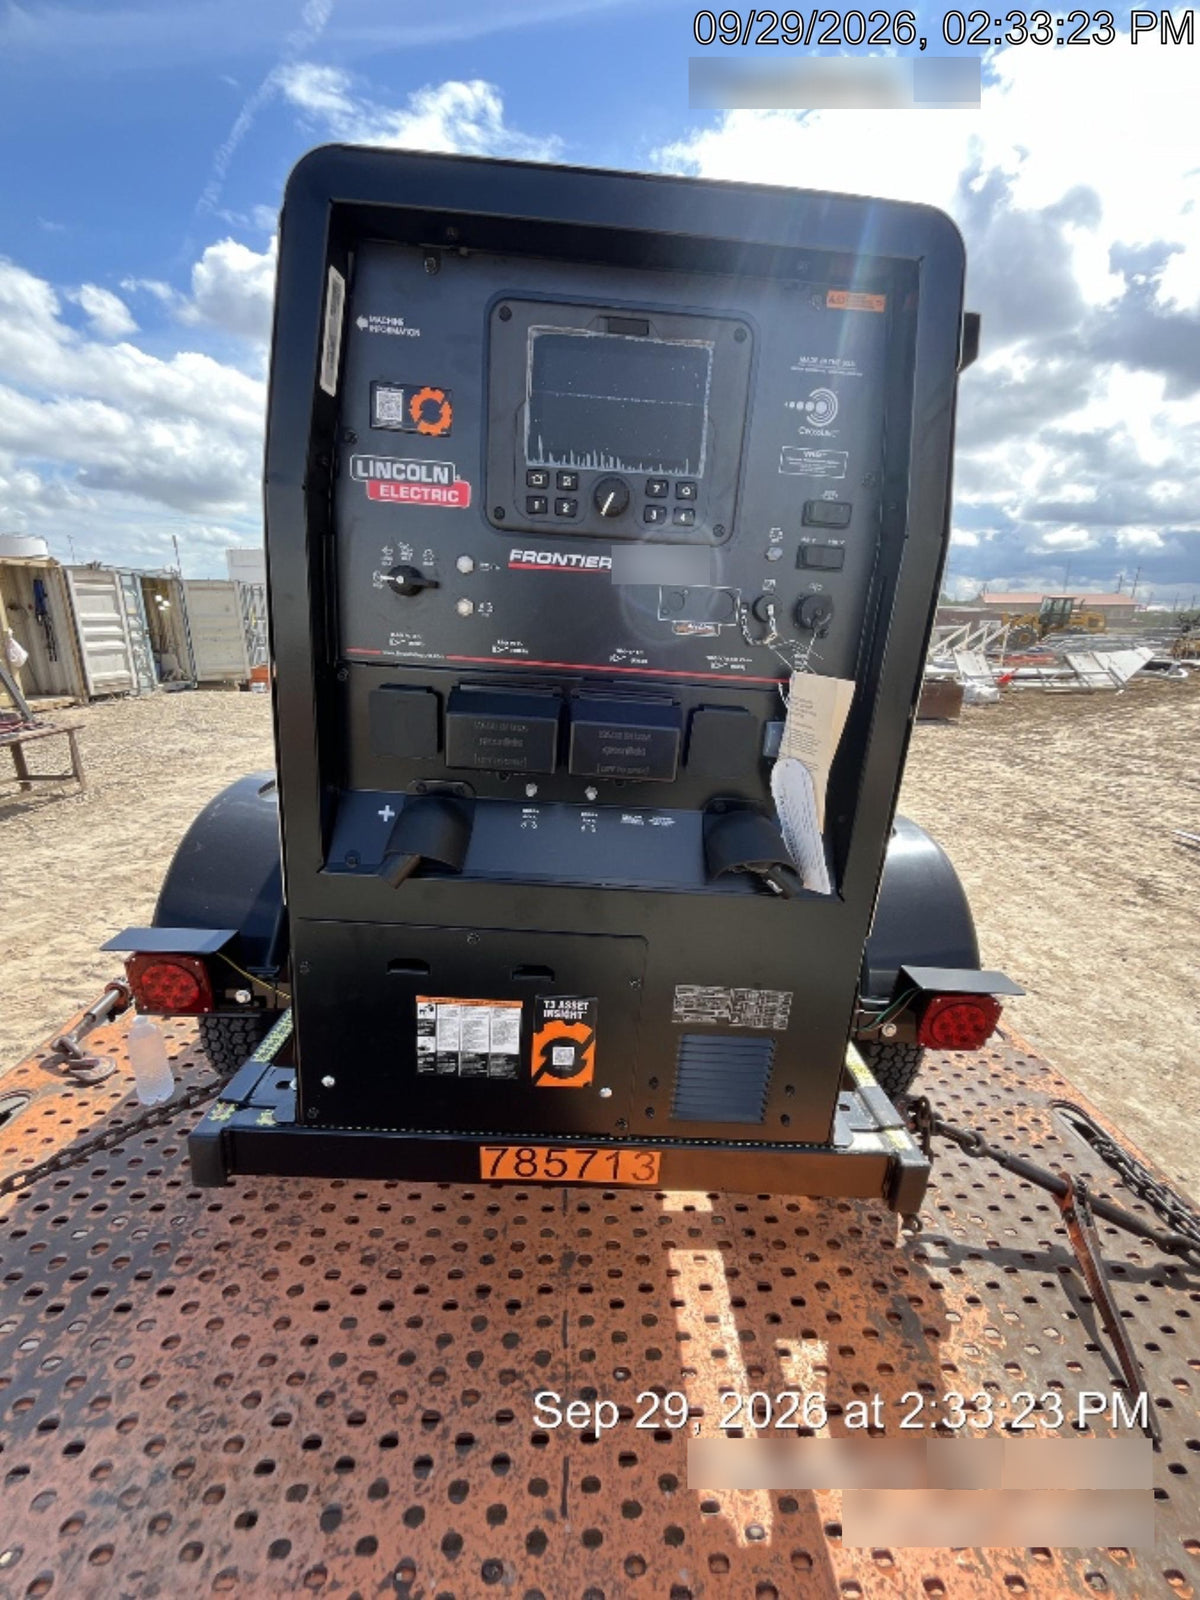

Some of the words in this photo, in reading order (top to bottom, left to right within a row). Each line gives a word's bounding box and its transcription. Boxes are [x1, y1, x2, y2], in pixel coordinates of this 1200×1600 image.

[357, 460, 449, 484] LINCOLN
[379, 484, 460, 503] ELECTRIC
[509, 549, 612, 569] FRONTIER
[543, 1000, 556, 1010] T3
[558, 1000, 589, 1012] ASSET
[543, 1009, 584, 1020] INSIGHT
[485, 1148, 656, 1181] 785713
